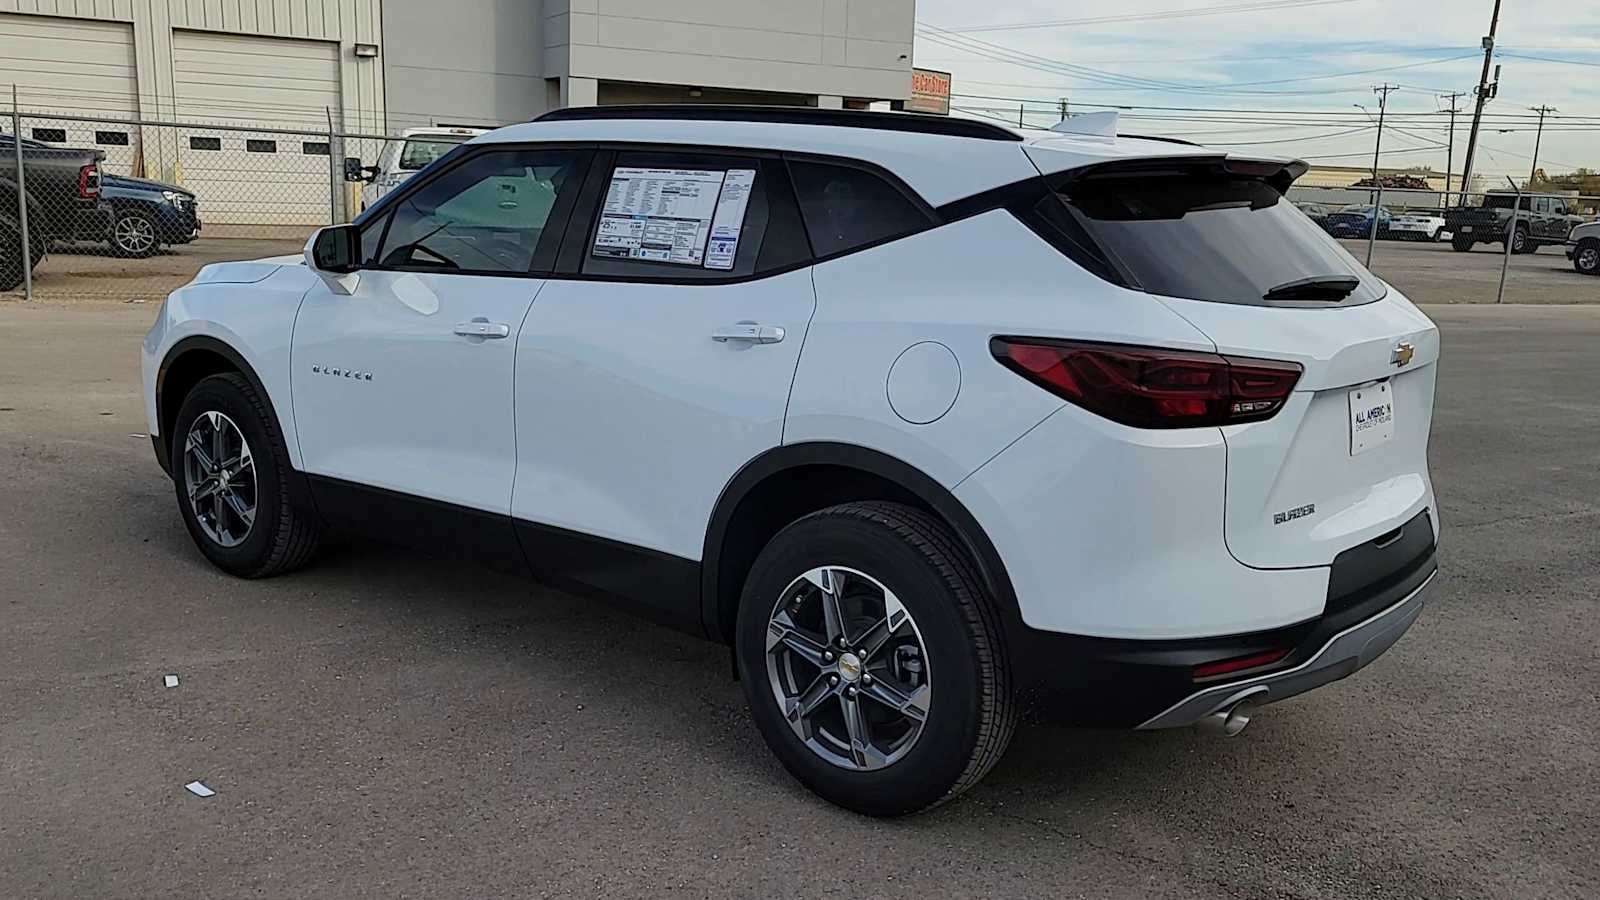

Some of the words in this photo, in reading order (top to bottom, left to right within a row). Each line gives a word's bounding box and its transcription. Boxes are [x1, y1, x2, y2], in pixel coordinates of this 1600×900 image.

[313, 365, 373, 381] BLAZER
[1355, 410, 1365, 424] ALL
[1367, 403, 1391, 421] AMERICN
[1273, 503, 1316, 525] BLAZER
